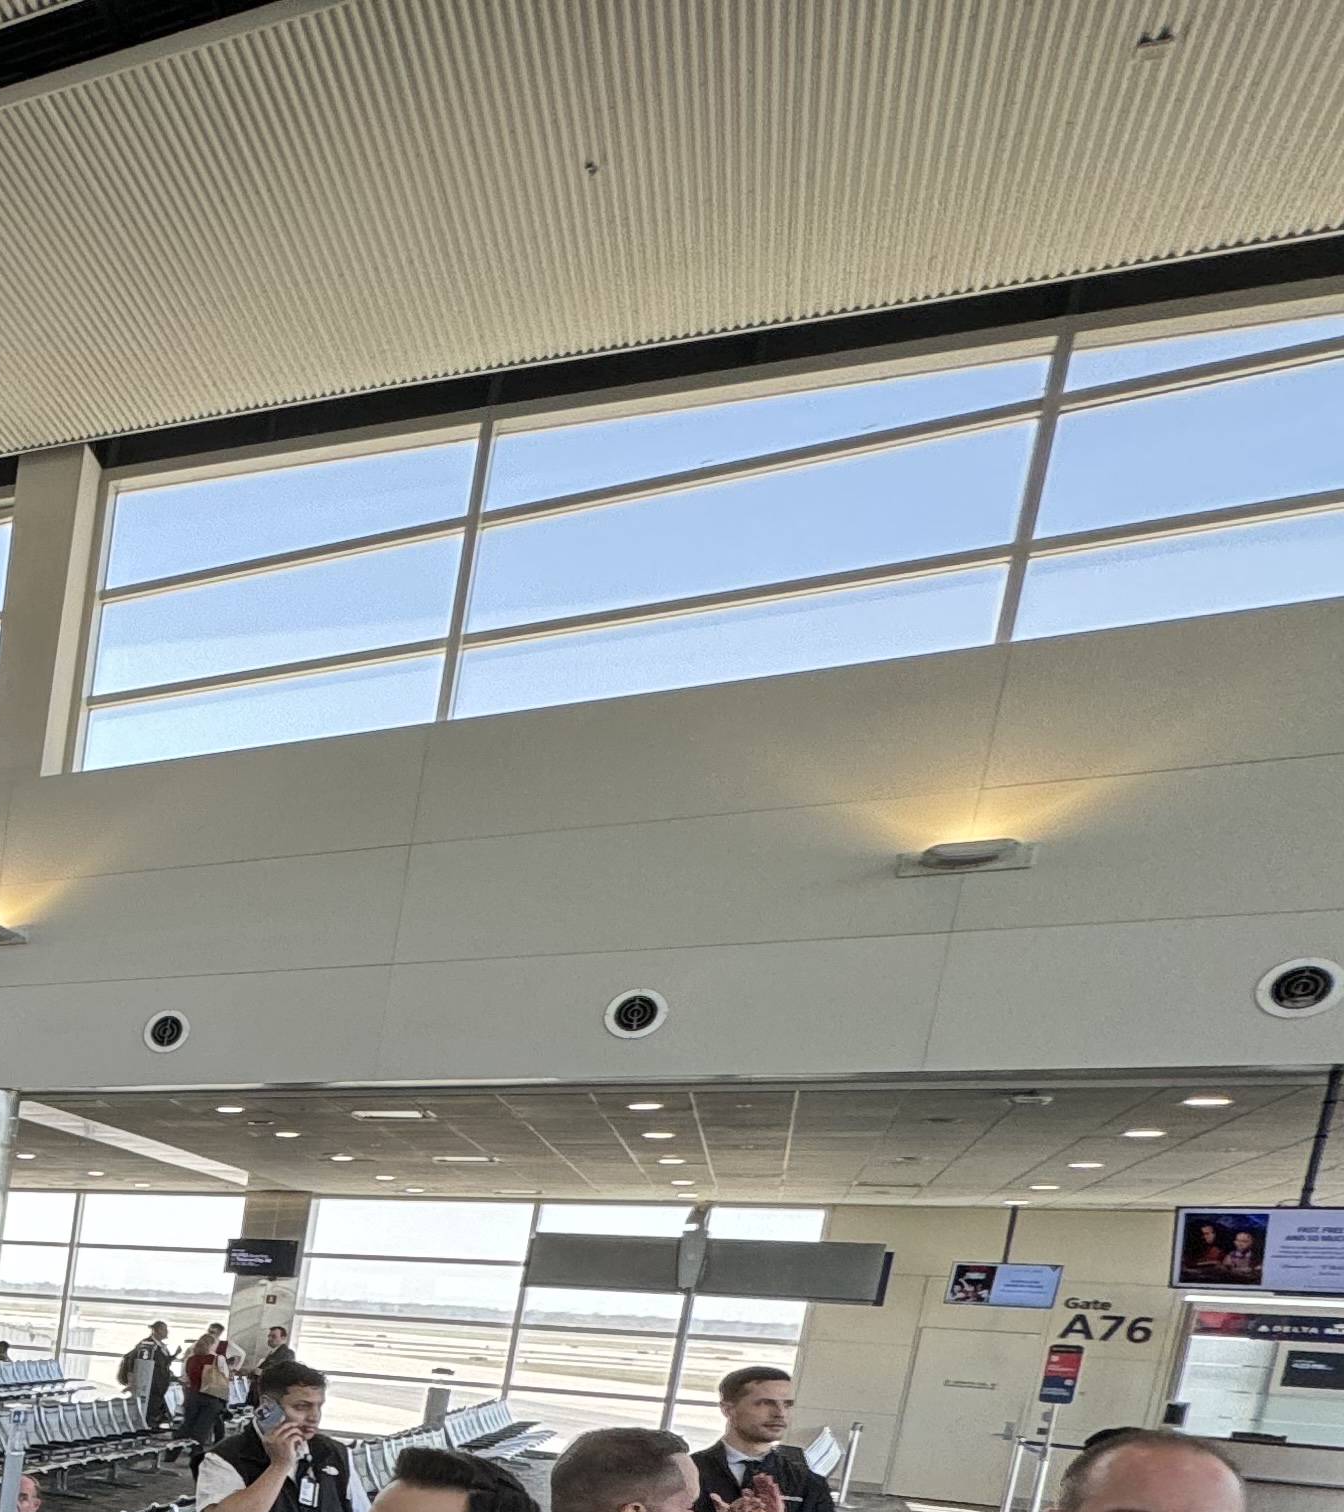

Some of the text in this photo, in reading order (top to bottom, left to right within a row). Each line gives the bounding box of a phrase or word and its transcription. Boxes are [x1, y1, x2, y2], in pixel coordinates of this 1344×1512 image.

[1063, 1297, 1112, 1311] Gate
[1057, 1313, 1154, 1344] A76
[1272, 1324, 1319, 1334] DELTA
